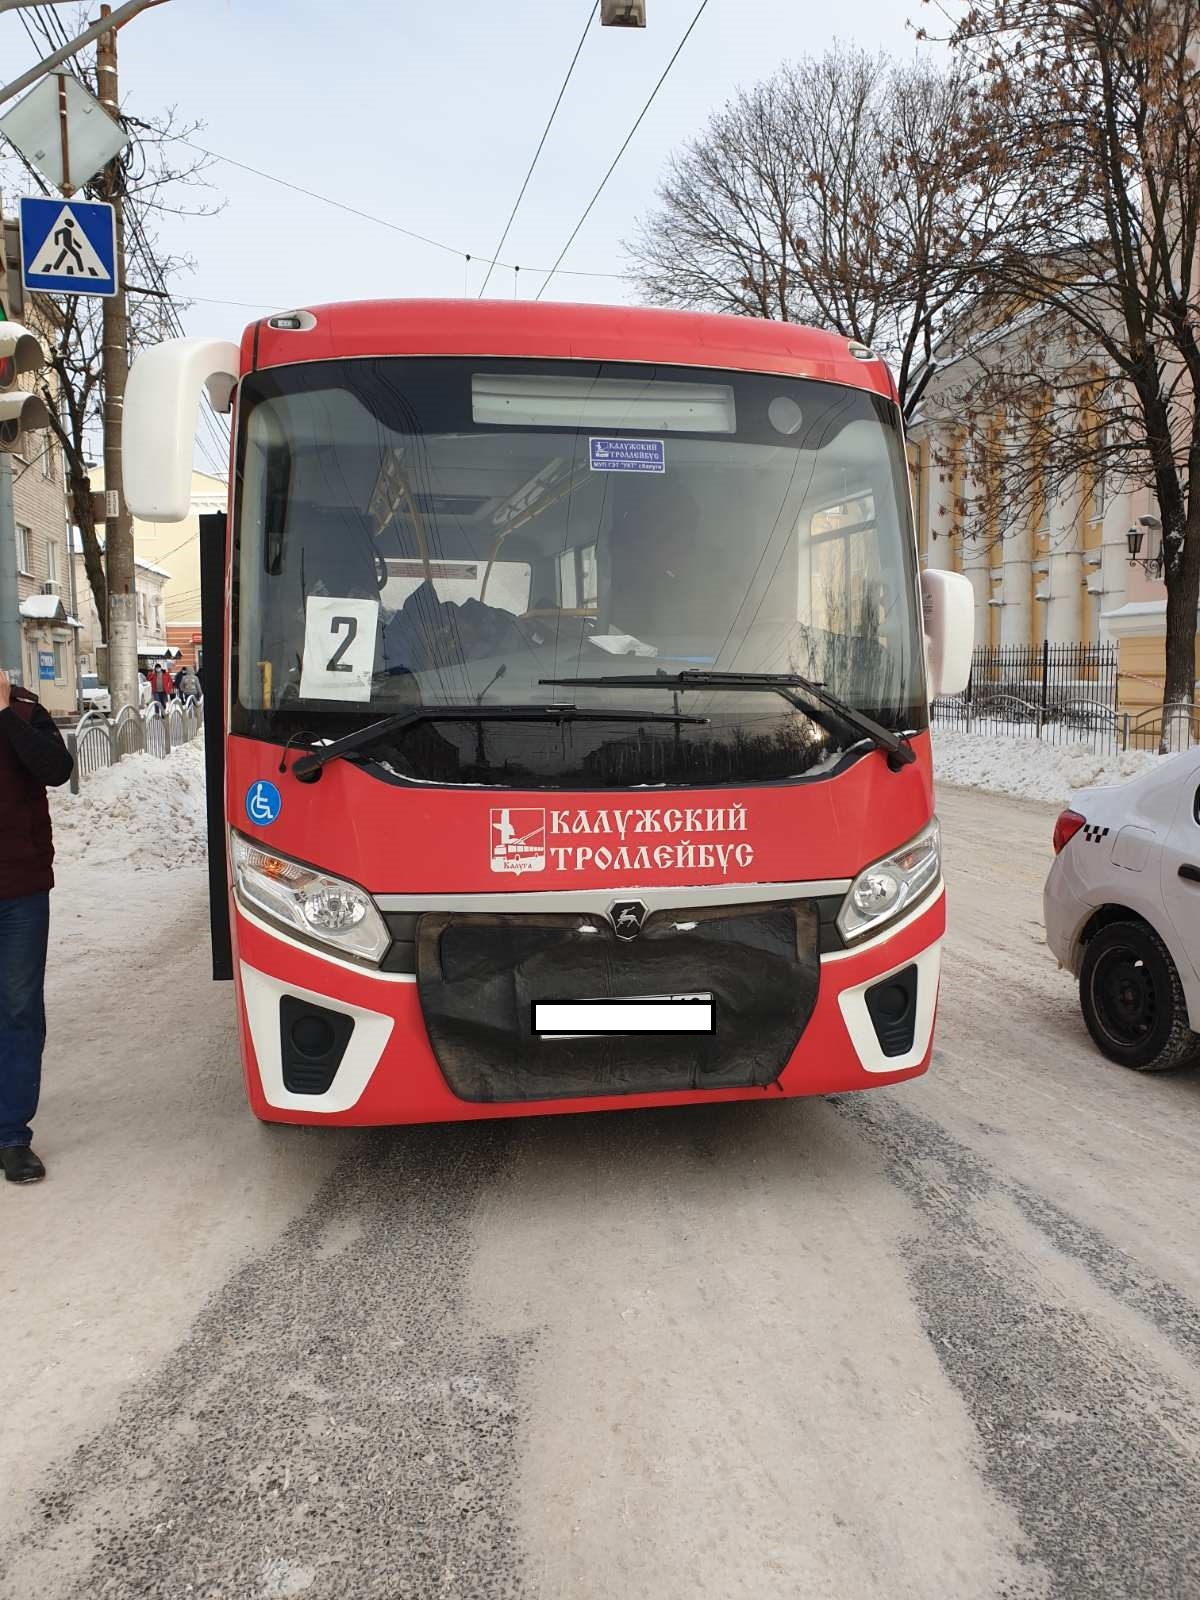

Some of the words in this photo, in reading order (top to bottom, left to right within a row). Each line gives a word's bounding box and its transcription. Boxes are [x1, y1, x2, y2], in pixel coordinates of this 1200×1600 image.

[609, 442, 657, 452] КАЛУЖСКИЙ
[610, 450, 660, 460] ТРОЛЛЕЙБУС
[326, 616, 358, 672] 2
[550, 802, 748, 840] КАЛУЖСКИЙ
[503, 861, 533, 871] Калуга
[550, 840, 754, 874] ТРОЛЛЕЙБУС
